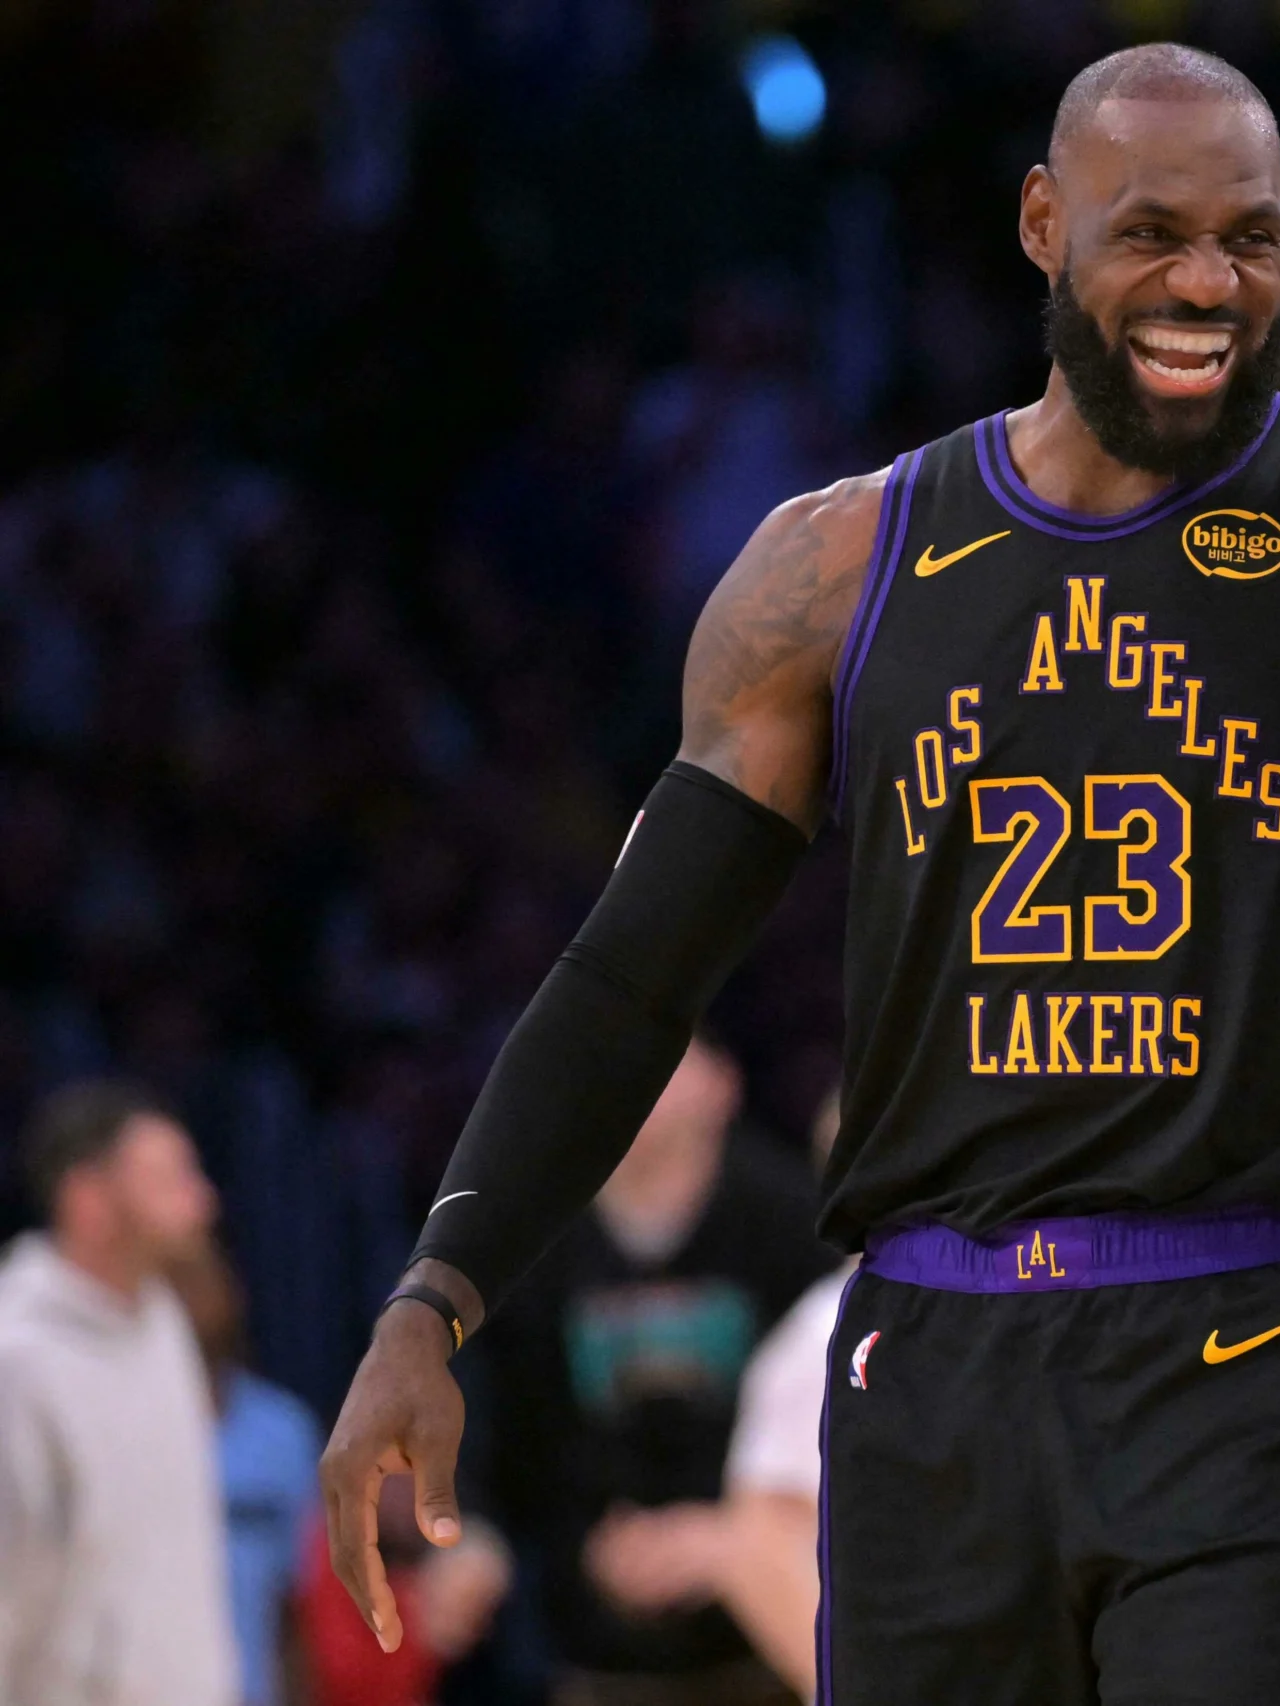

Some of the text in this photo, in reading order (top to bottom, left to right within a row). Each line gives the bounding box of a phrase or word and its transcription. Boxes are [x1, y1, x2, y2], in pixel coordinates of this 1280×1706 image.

[1208, 548, 1246, 563] 비비고
[894, 685, 982, 856] LOS
[968, 773, 1192, 964] 23
[968, 993, 1202, 1077] LAKERS
[1016, 1230, 1066, 1279] LAL
